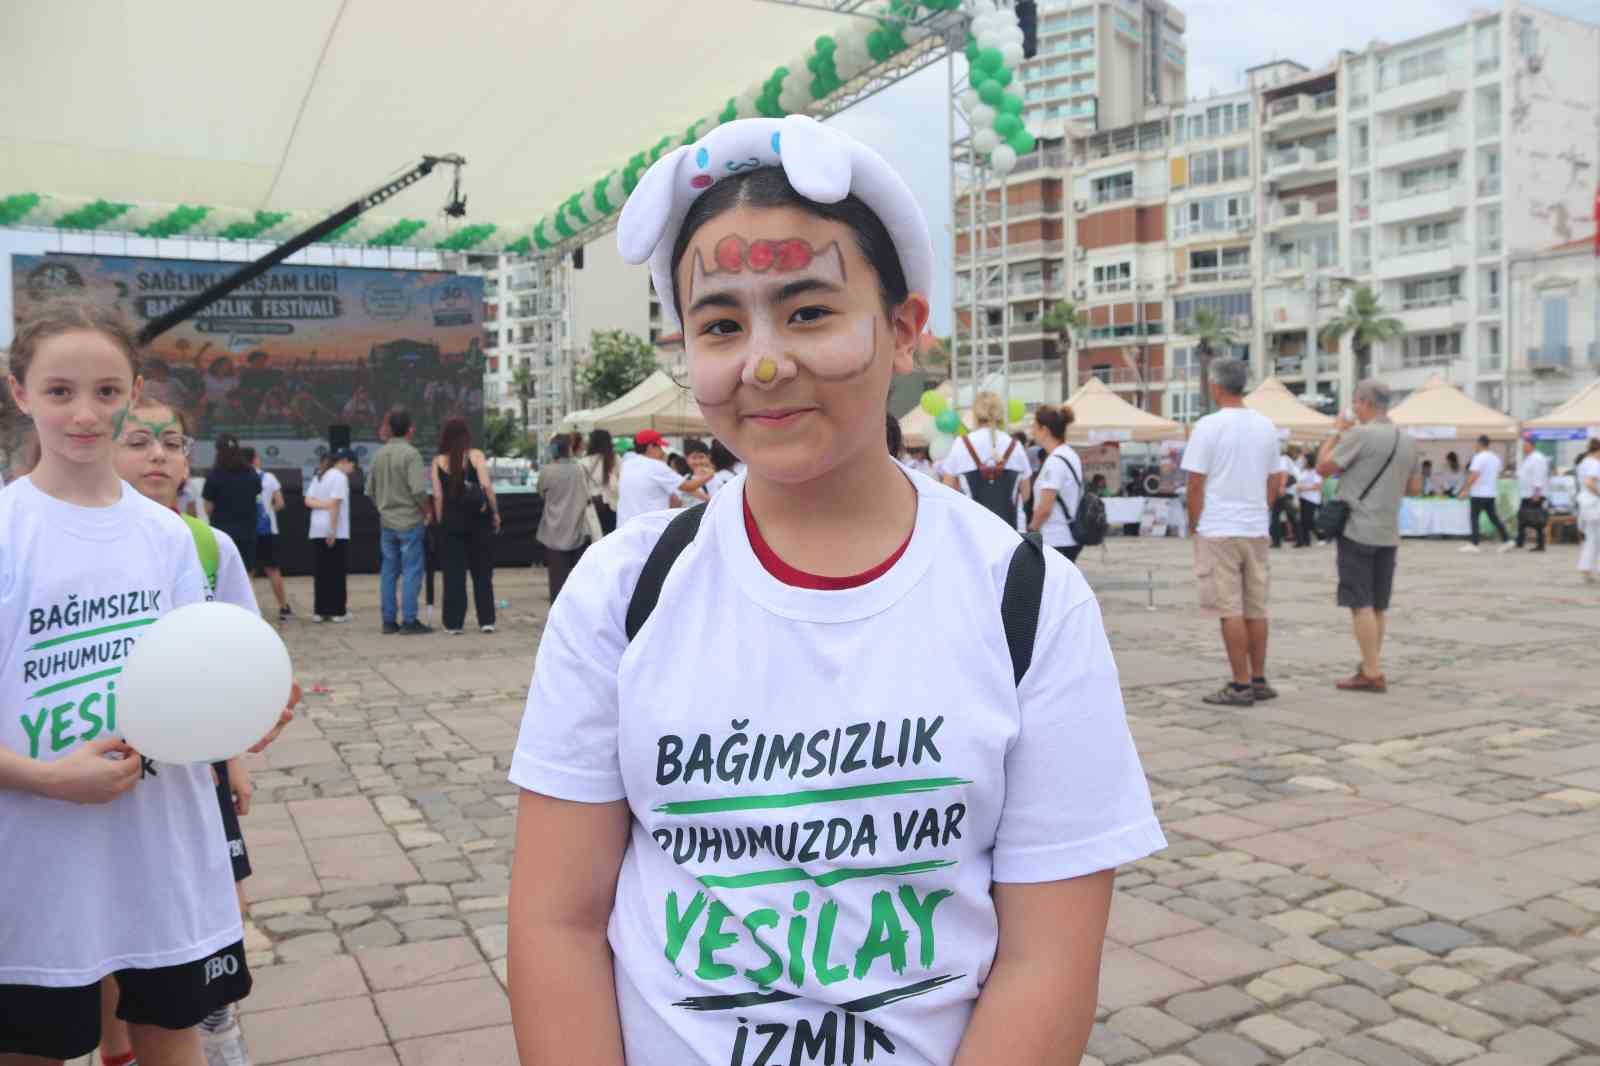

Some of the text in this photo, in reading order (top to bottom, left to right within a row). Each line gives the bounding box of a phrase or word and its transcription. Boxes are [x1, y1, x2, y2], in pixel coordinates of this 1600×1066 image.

[136, 269, 220, 290] SAĞLIKL
[304, 269, 336, 292] LİGİ
[261, 297, 335, 317] FESTİVALİ
[24, 636, 136, 683] RUHUMUZD
[655, 715, 945, 786] BAĞIMSIZLIK
[892, 803, 967, 852] VAR
[663, 883, 955, 994] YEŞİLAY
